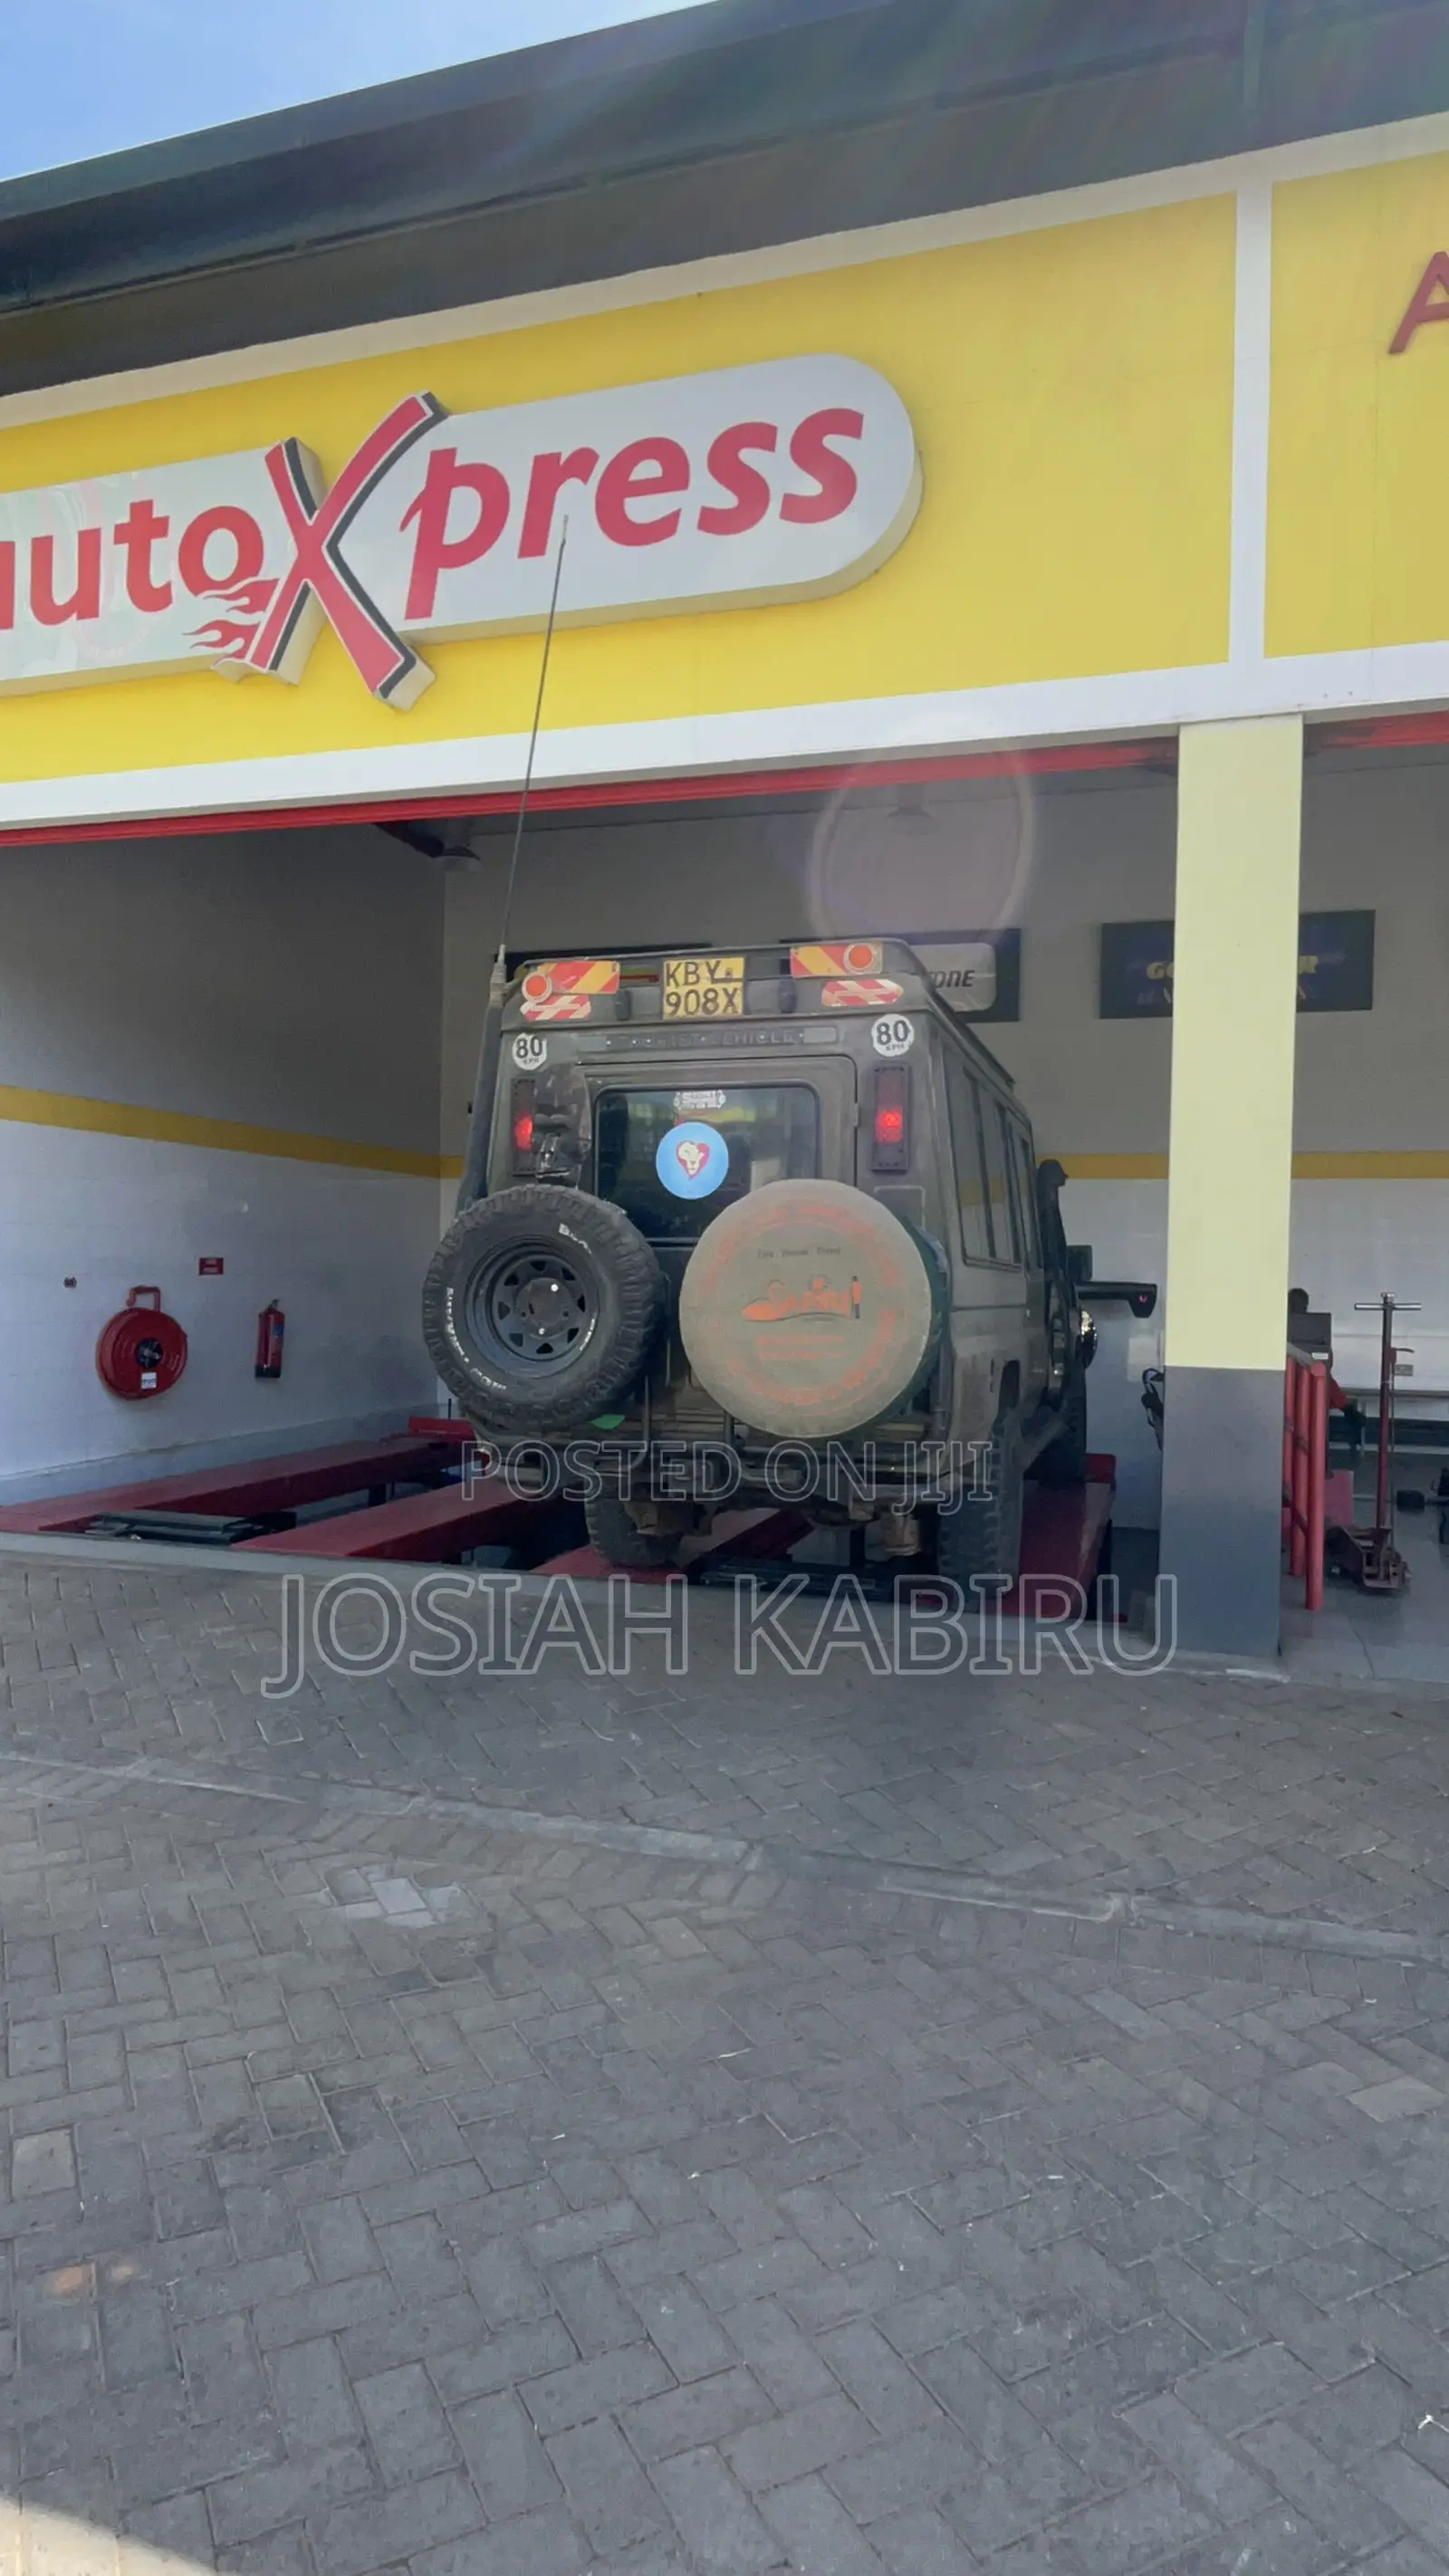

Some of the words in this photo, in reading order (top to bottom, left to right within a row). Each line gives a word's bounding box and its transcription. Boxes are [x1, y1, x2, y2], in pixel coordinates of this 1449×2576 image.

[0, 391, 864, 697] utoXpress
[666, 960, 721, 987] KBY
[666, 987, 739, 1016] 908X
[876, 1020, 909, 1045] 80
[516, 1035, 543, 1059] 80
